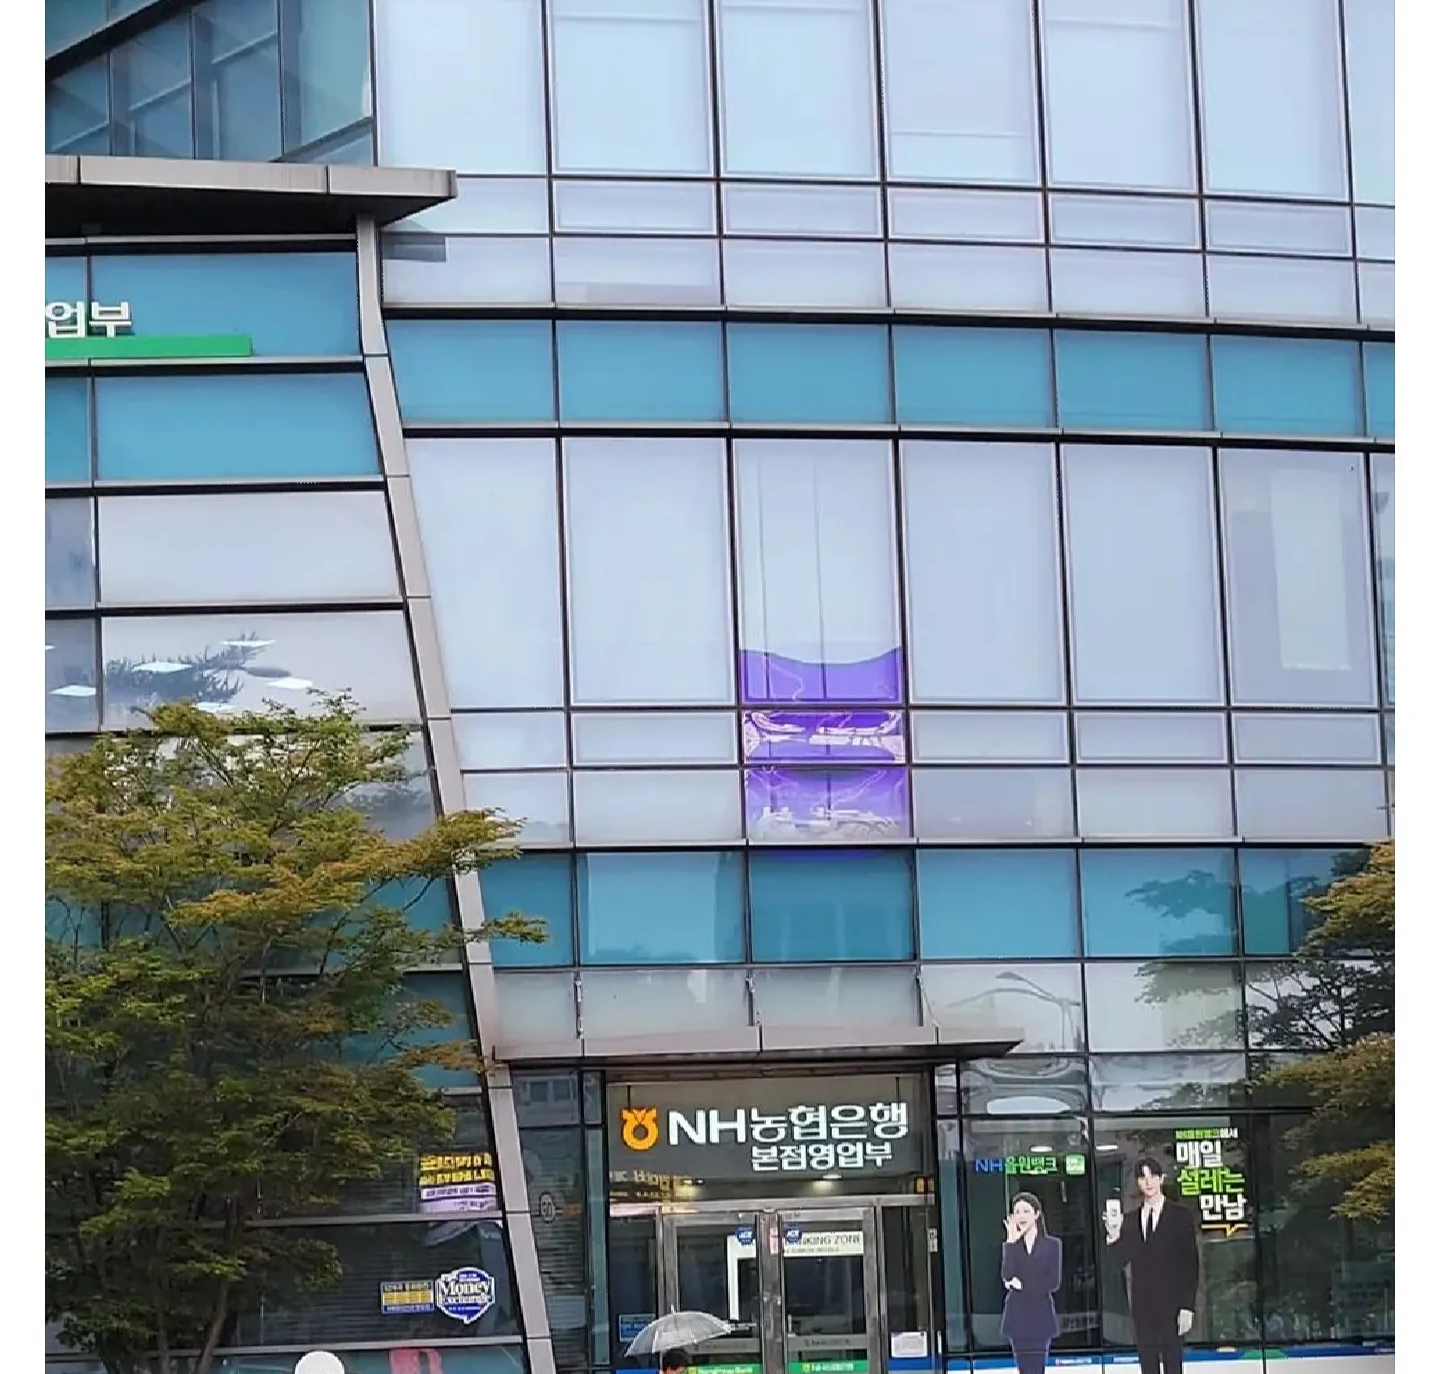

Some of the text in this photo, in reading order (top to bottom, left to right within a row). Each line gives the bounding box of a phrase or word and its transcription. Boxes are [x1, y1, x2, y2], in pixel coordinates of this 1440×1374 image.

[45, 301, 132, 338] 업부
[668, 1102, 909, 1146] NH농협은행
[751, 1142, 893, 1171] 본점영업부
[1176, 1140, 1223, 1167] 매일
[1177, 1167, 1245, 1195] 설레는
[1200, 1194, 1248, 1221] 만남
[438, 1280, 491, 1296] Money
